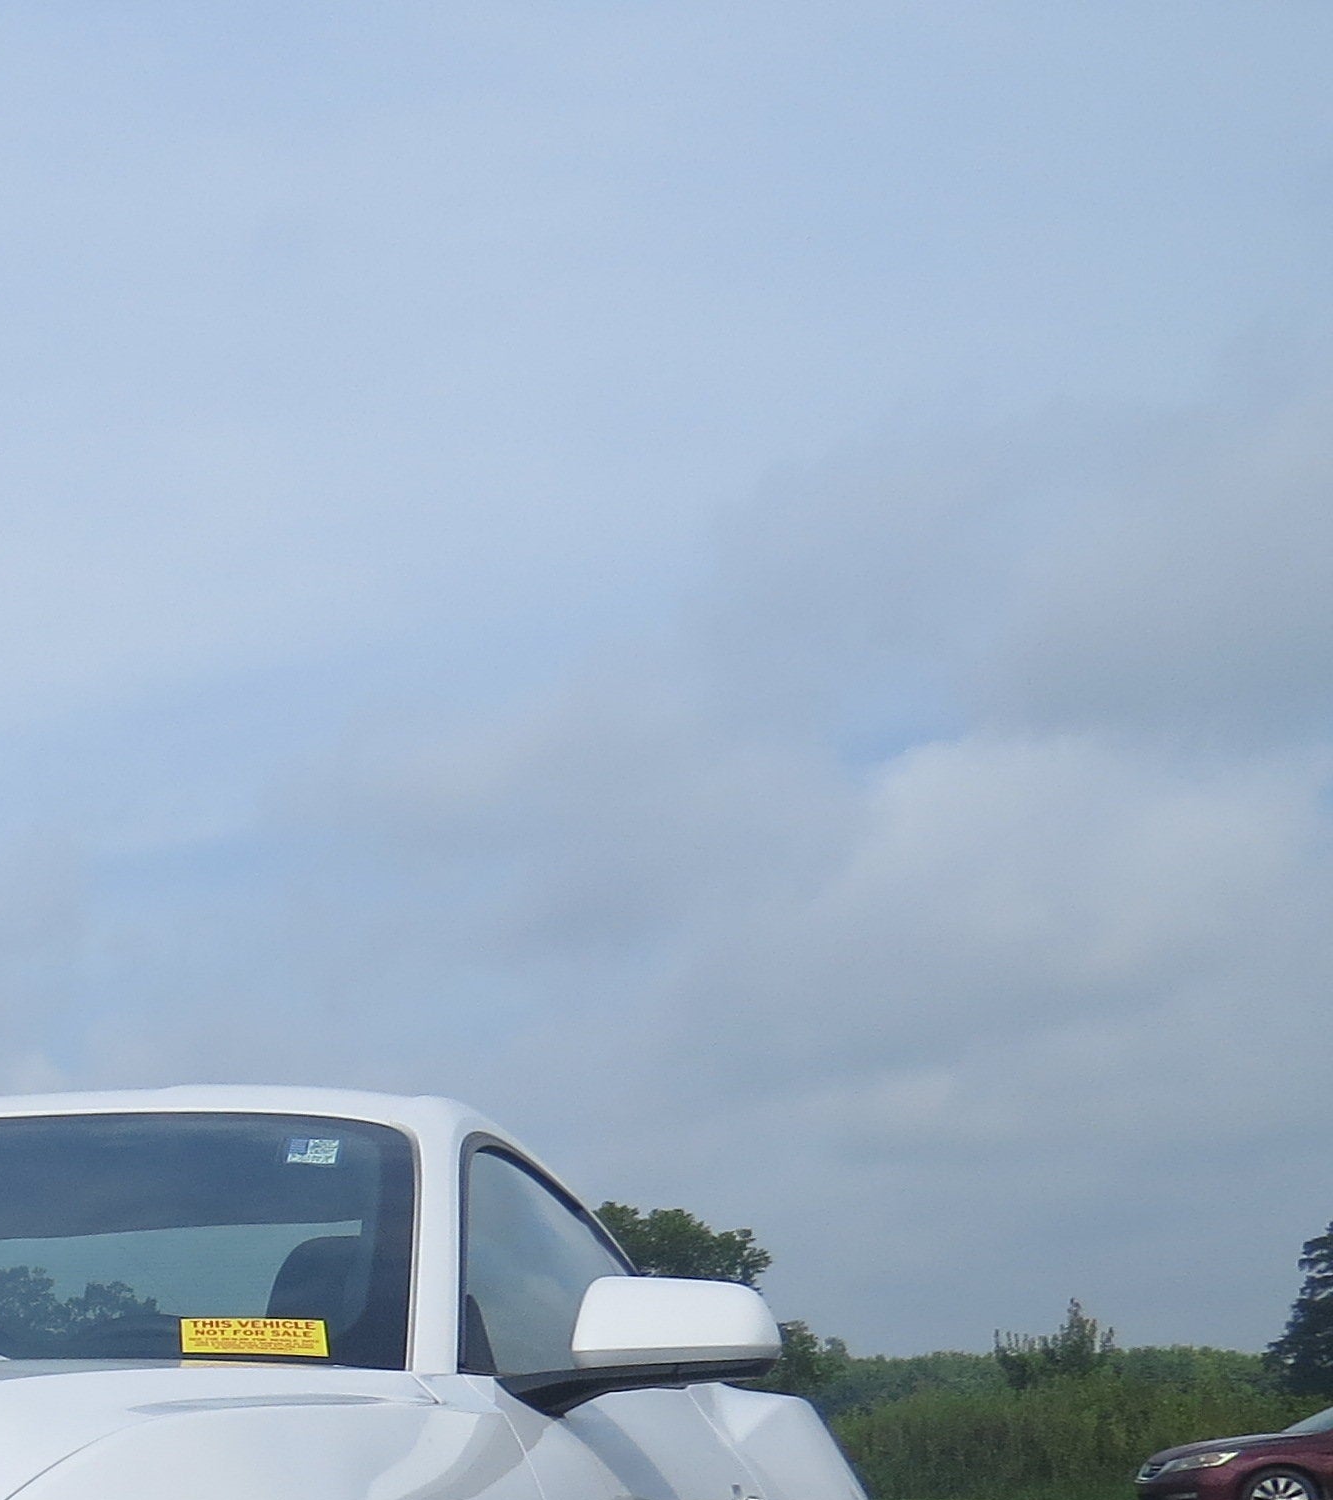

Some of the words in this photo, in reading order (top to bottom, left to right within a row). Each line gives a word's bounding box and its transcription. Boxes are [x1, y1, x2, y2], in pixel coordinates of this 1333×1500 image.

[190, 1320, 233, 1329] THIS
[237, 1320, 316, 1330] VEHICLE
[233, 1329, 265, 1337] FOR
[271, 1330, 313, 1338] SALE
